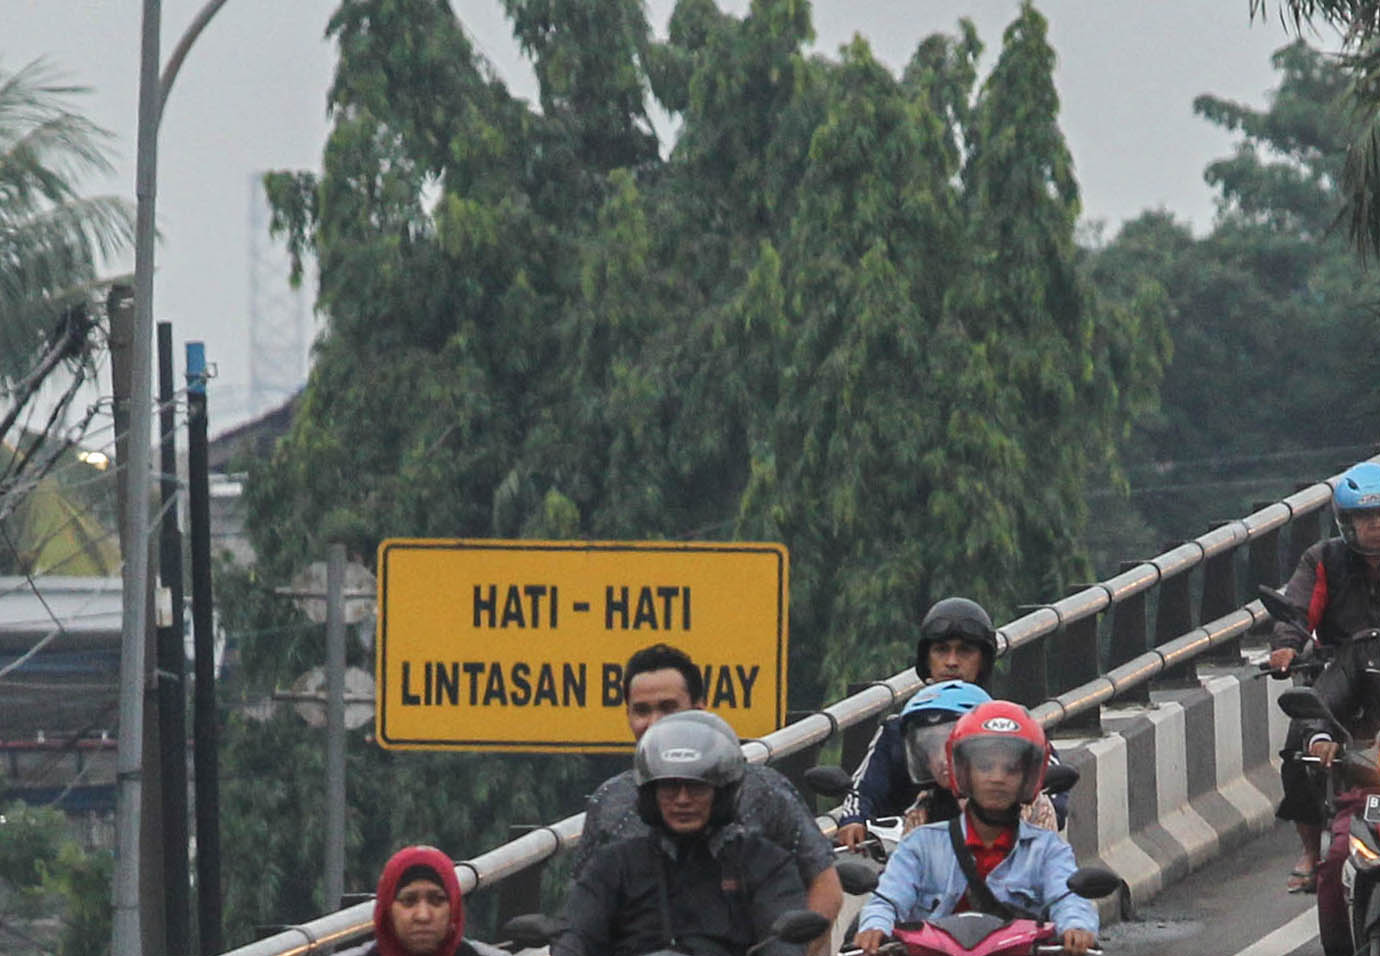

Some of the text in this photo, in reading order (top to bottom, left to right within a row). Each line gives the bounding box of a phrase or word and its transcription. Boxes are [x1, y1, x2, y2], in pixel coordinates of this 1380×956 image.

[473, 584, 558, 629] HATI
[605, 586, 692, 631] HATI
[401, 661, 588, 707] LINTASAN
[1369, 797, 1379, 808] B
